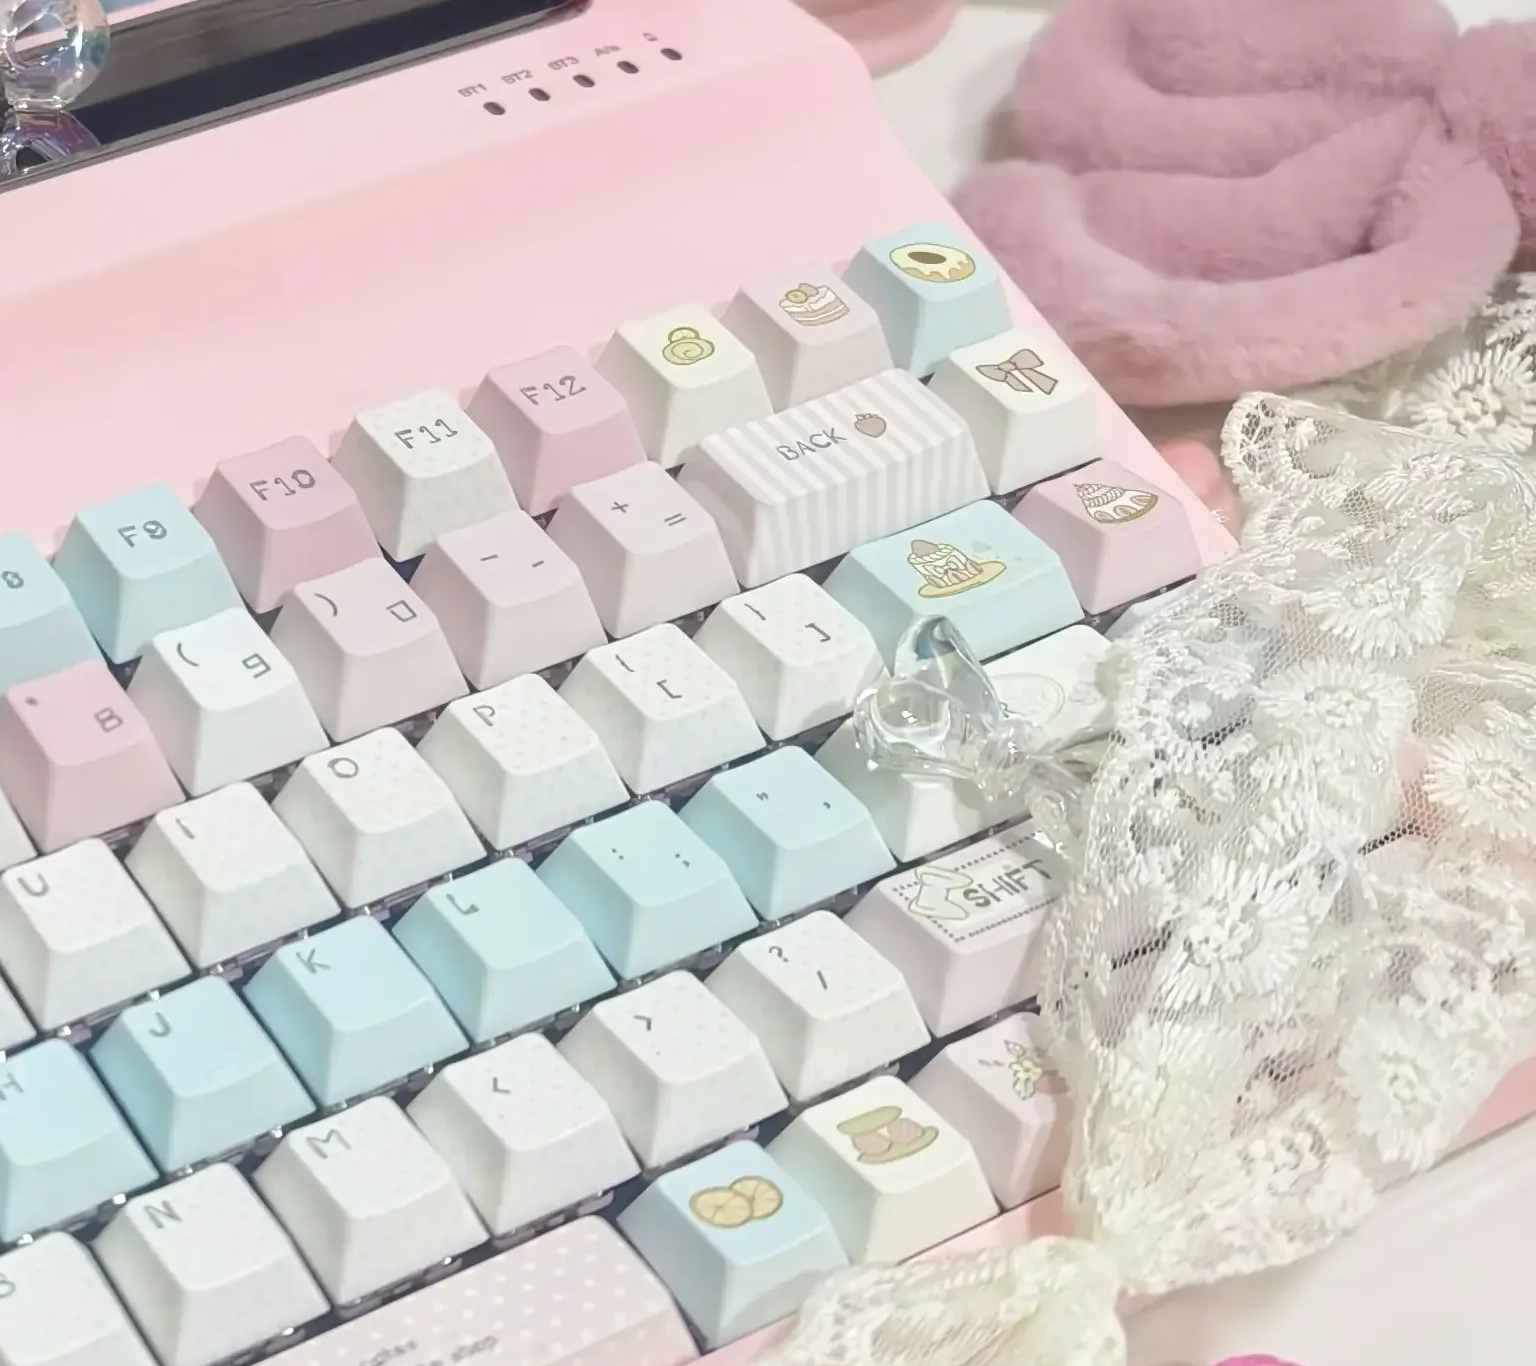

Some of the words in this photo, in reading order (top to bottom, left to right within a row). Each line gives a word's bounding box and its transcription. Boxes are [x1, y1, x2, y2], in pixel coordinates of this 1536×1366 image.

[548, 56, 579, 70] BT3
[458, 84, 487, 97] BT1
[501, 70, 533, 84] BT2
[519, 375, 587, 406] F12
[394, 418, 459, 450] F11
[775, 427, 847, 461] BACK
[249, 469, 316, 502] F10
[117, 519, 168, 548] F9
[241, 652, 272, 679] 9
[93, 706, 124, 734] 8
[472, 704, 496, 728] P
[327, 757, 360, 779] O
[18, 873, 50, 898] U
[962, 858, 1052, 910] SHIFT
[446, 893, 480, 916] L
[296, 948, 331, 975] K
[149, 1011, 172, 1038] J
[307, 1128, 351, 1160] M
[145, 1200, 183, 1230] N
